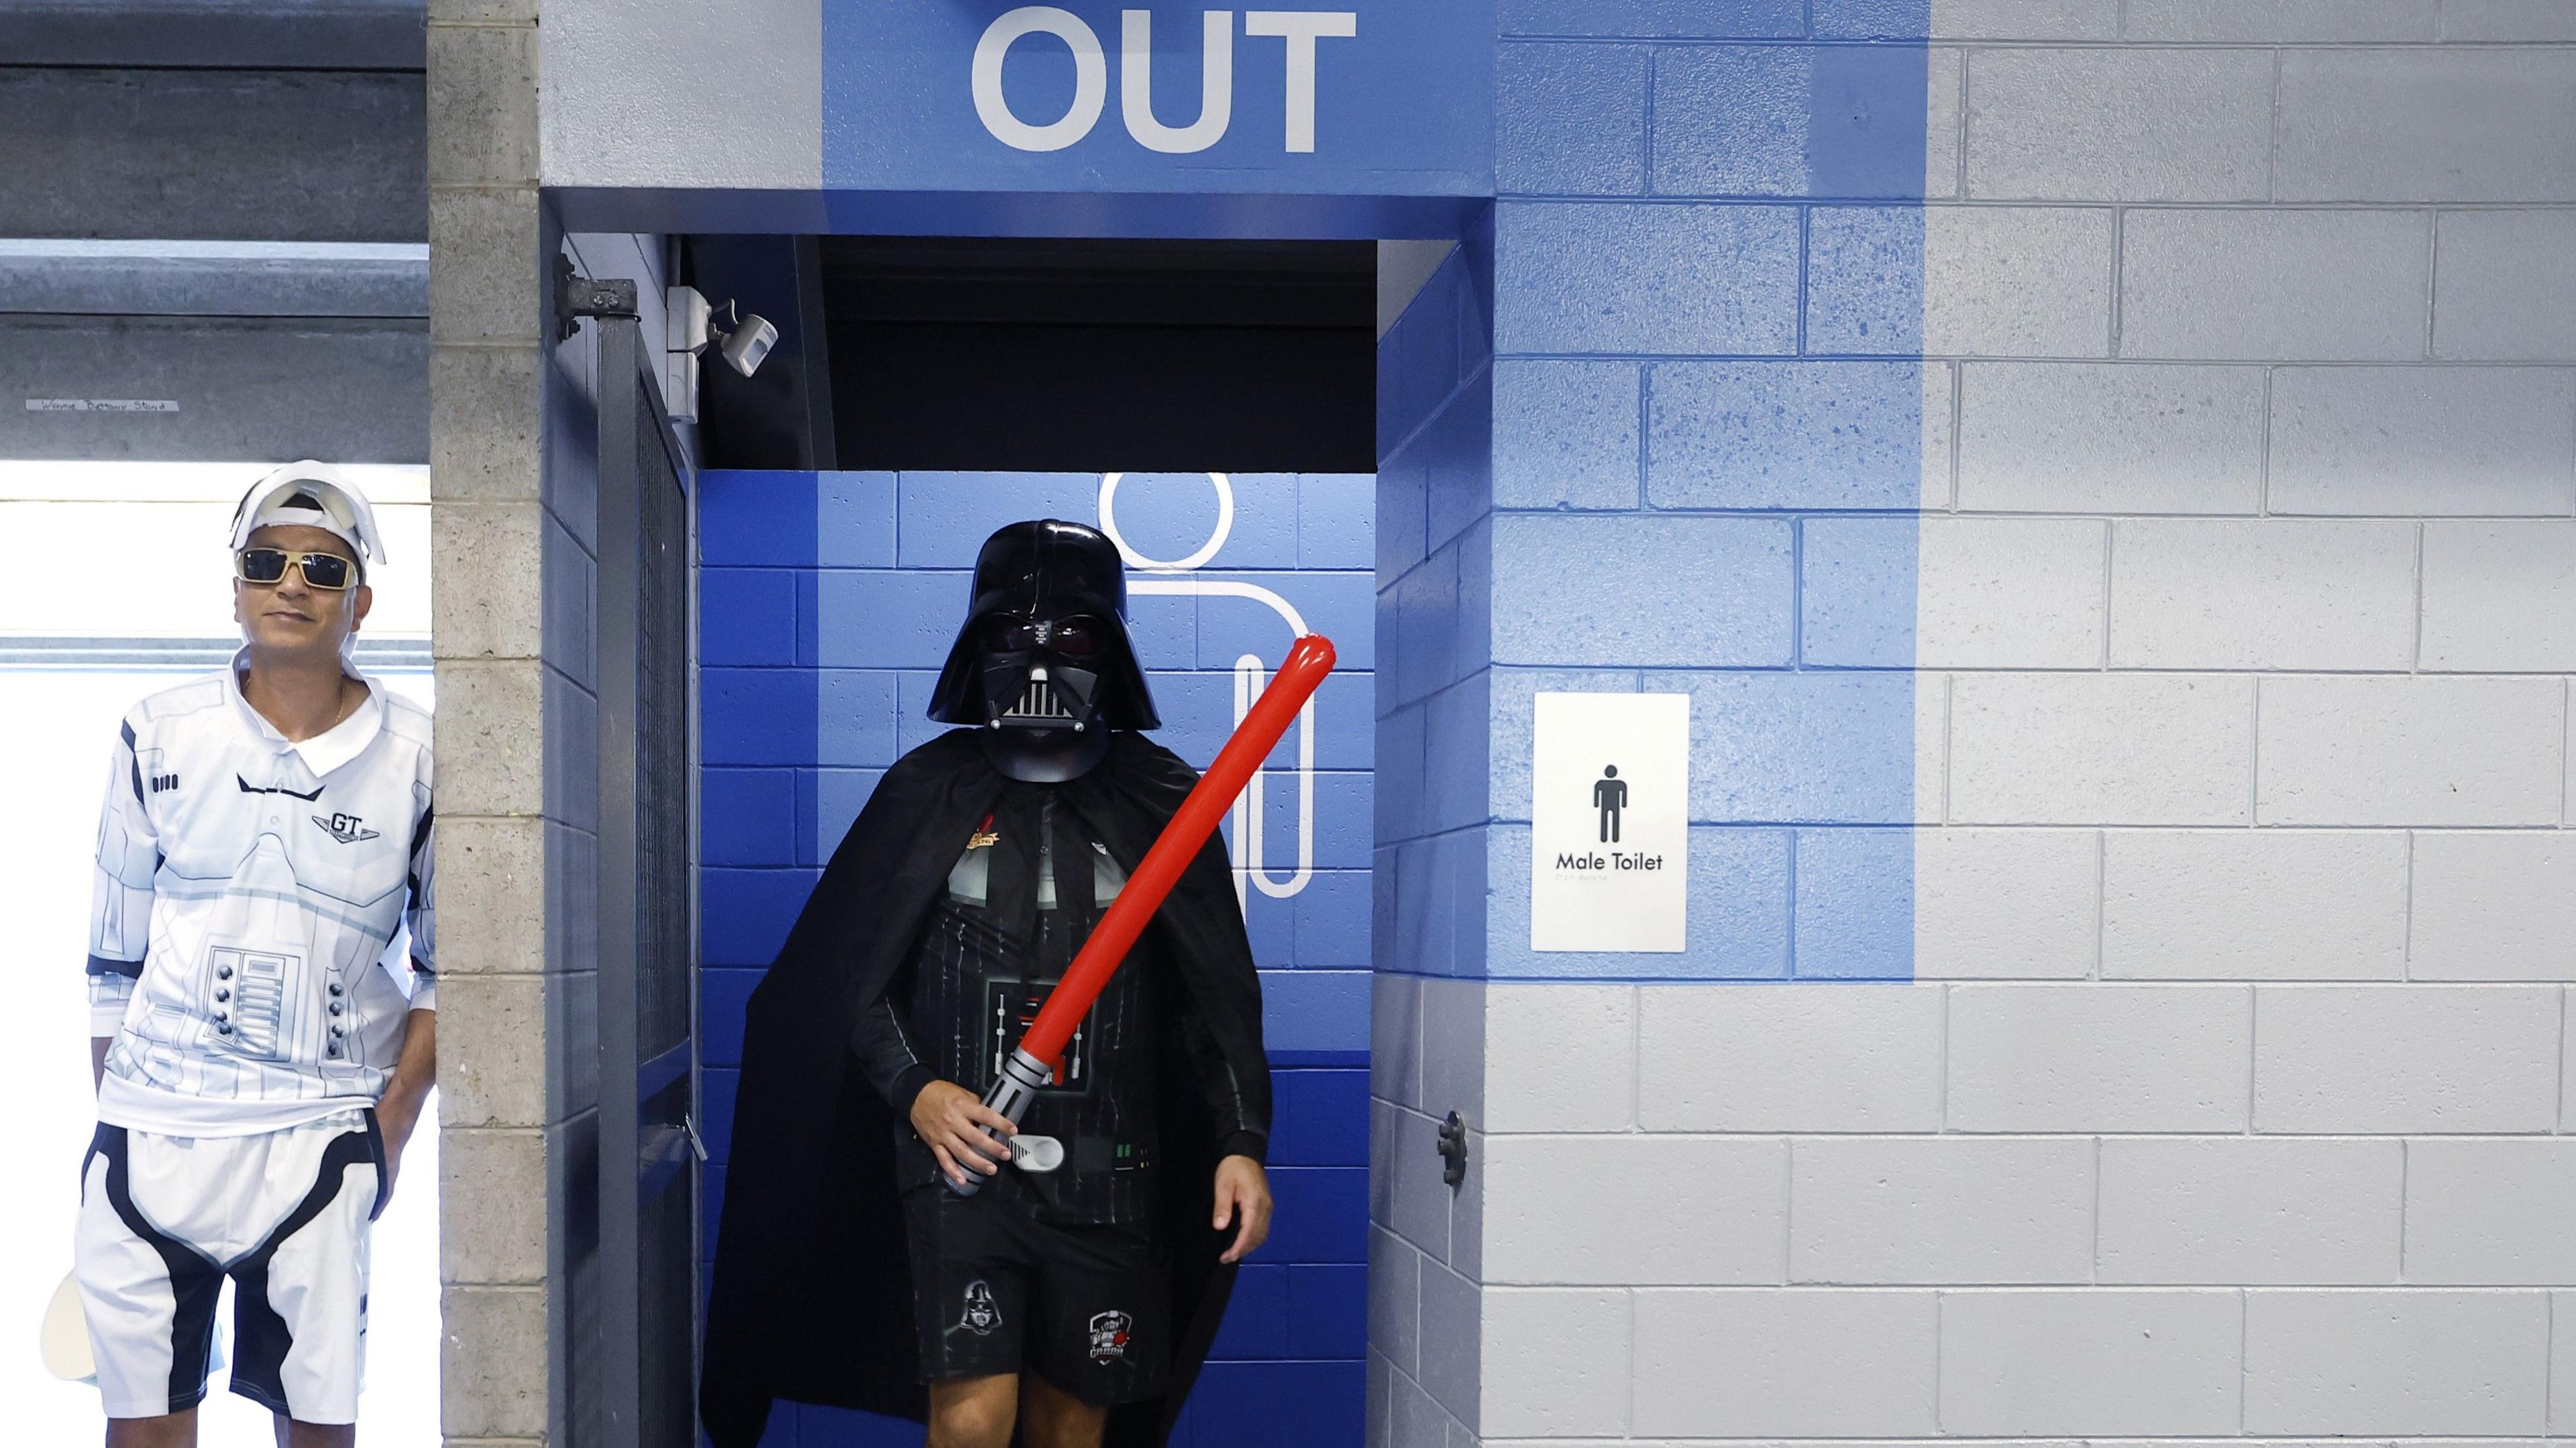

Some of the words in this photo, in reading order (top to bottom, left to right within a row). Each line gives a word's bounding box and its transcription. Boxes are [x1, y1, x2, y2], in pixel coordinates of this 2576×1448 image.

[971, 5, 1356, 154] OUT
[134, 400, 165, 410] Stand
[331, 813, 362, 834] GT
[1556, 852, 1605, 870] Male
[1611, 852, 1662, 870] Toilet
